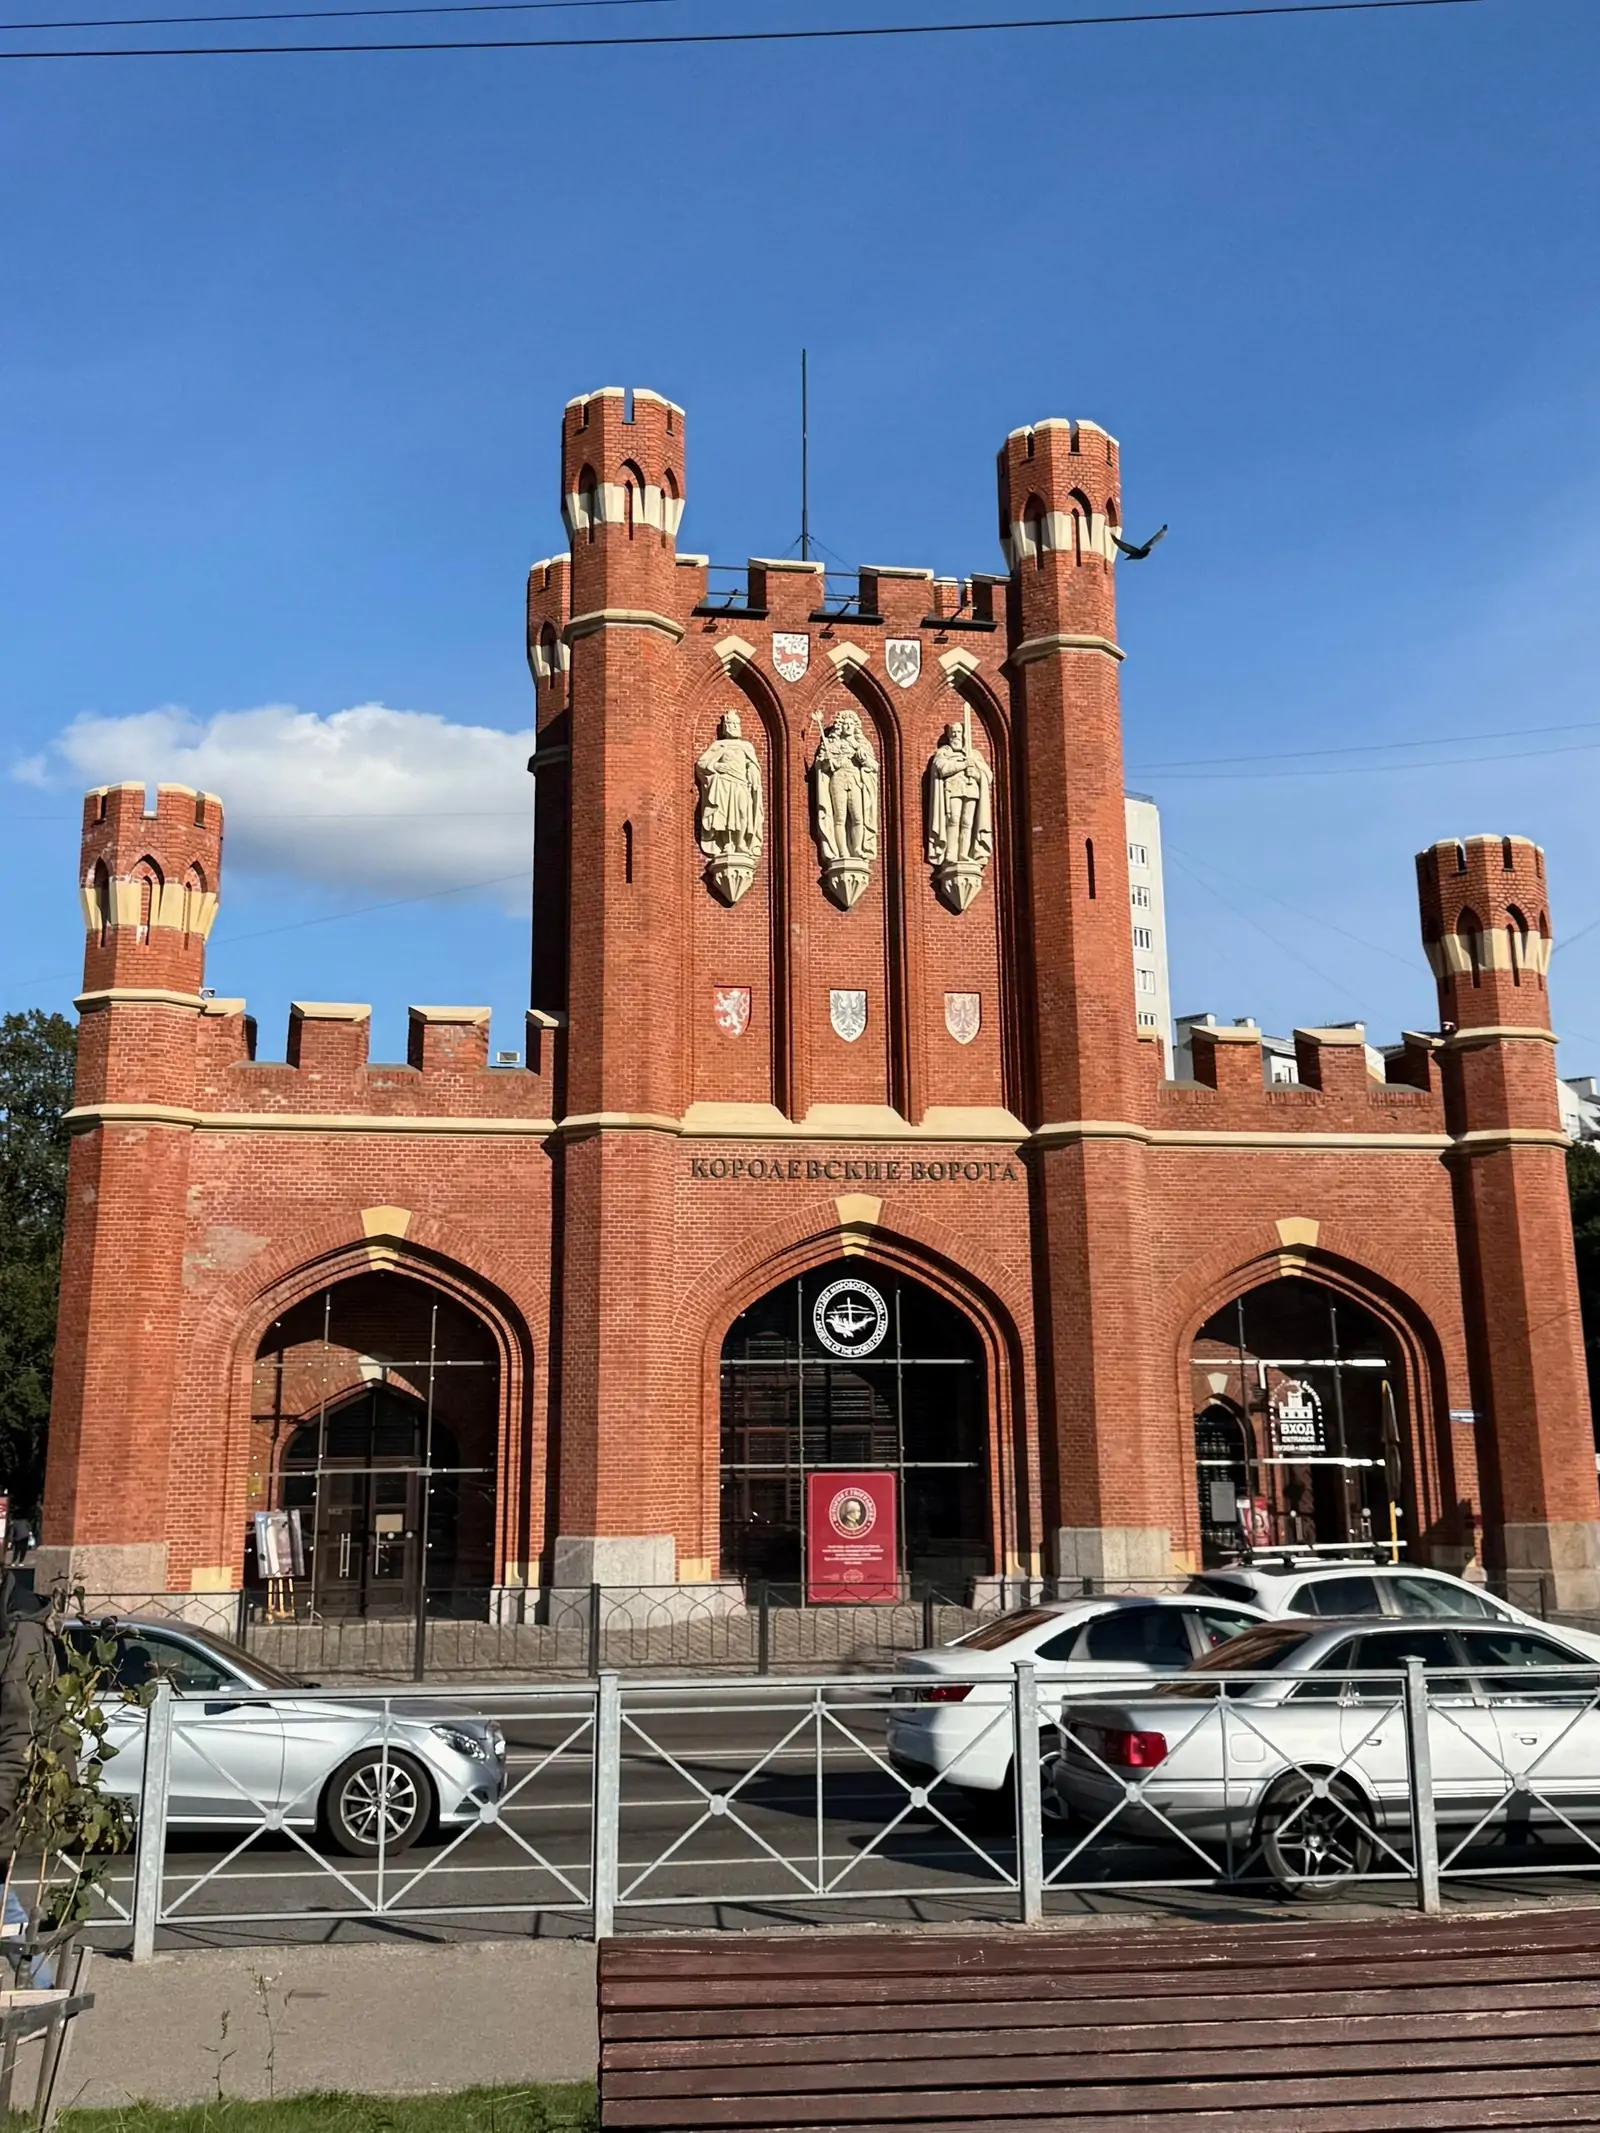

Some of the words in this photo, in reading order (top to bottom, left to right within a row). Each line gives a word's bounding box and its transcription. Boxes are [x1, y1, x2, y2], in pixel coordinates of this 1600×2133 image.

[690, 1157, 901, 1180] КОРОЛЕВСКИЕ
[910, 1161, 1018, 1181] ВОРОТА
[829, 1281, 867, 1293] МИРОВОГО
[866, 1288, 885, 1314] ОКЕАНА
[1280, 1423, 1316, 1436] ВХОД
